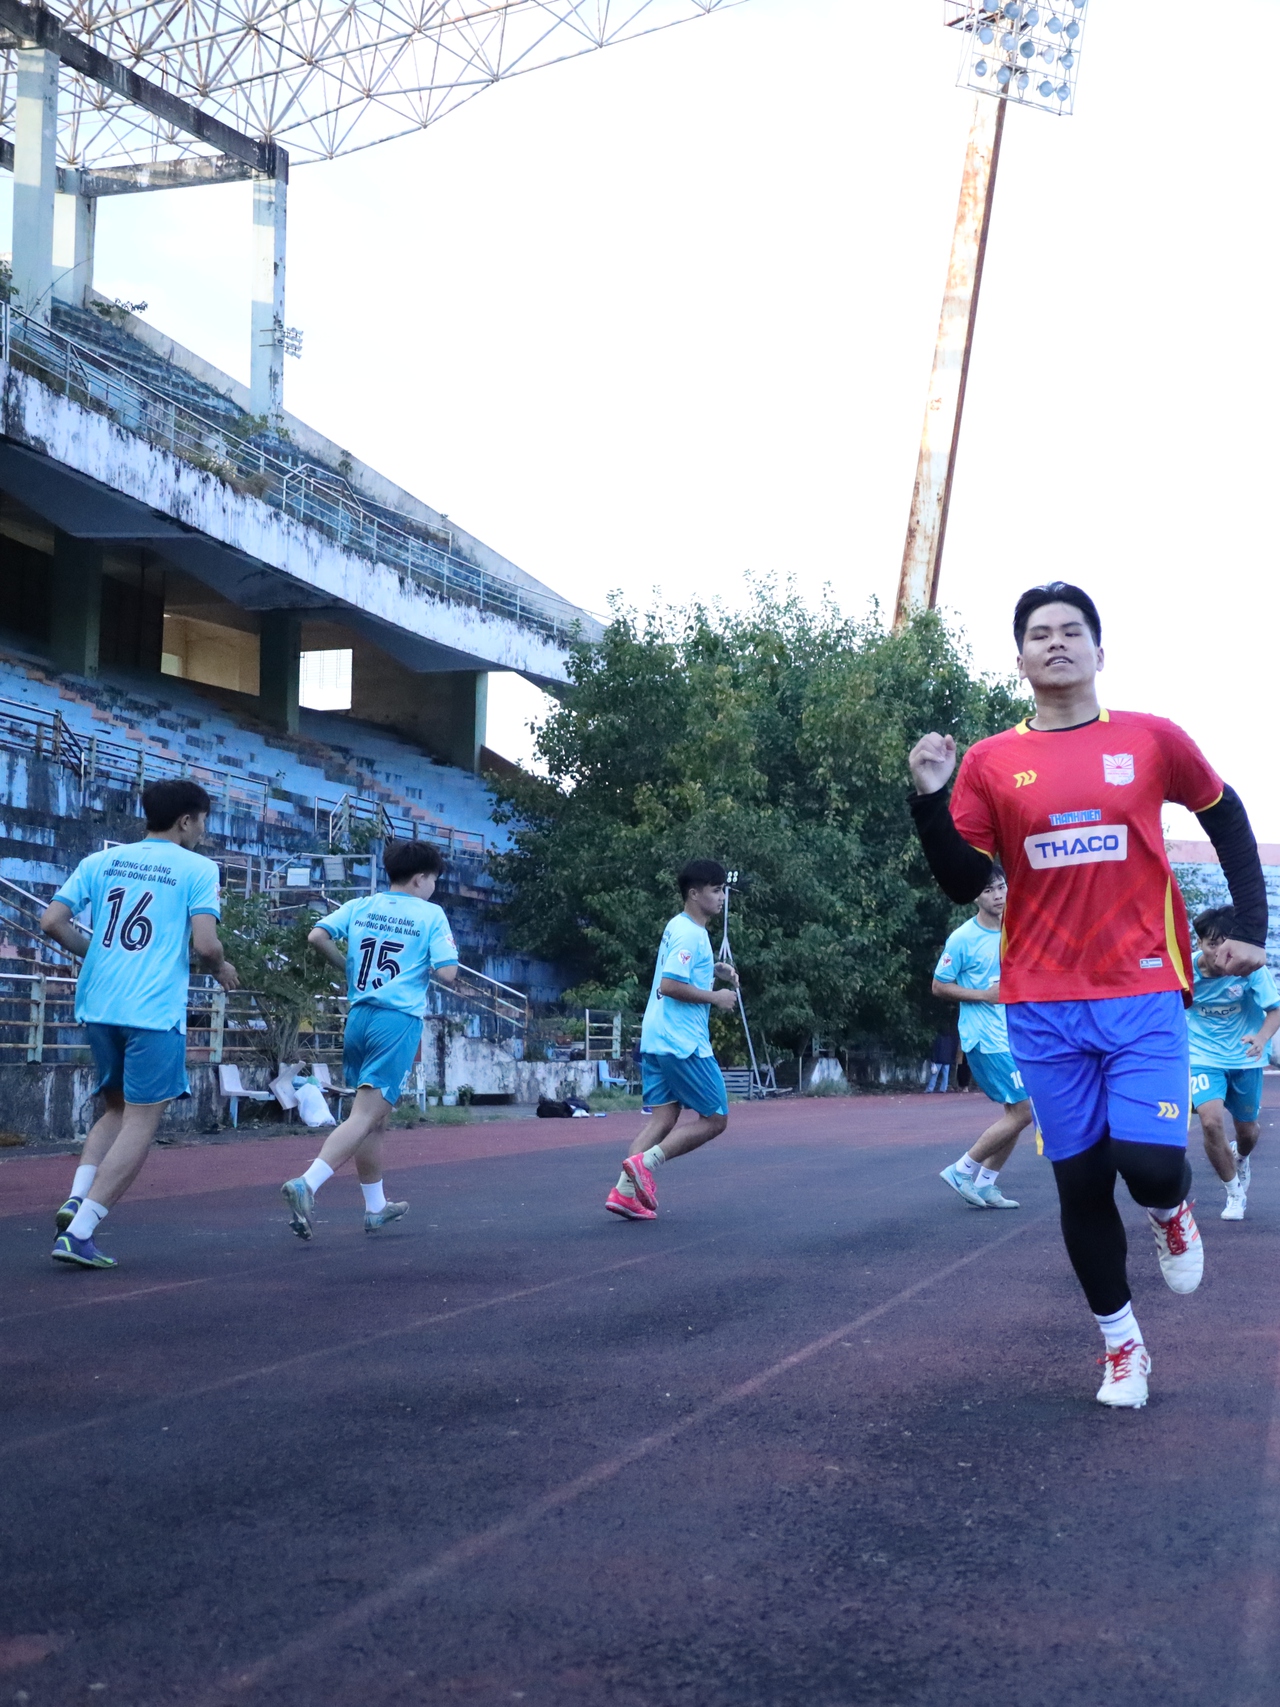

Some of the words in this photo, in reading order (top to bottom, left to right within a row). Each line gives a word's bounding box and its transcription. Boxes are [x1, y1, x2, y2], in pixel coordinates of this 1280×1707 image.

[1034, 835, 1119, 858] THACO
[140, 863, 152, 872] CAO
[102, 887, 153, 951] 16
[357, 937, 404, 991] 15
[1191, 1073, 1210, 1095] 20
